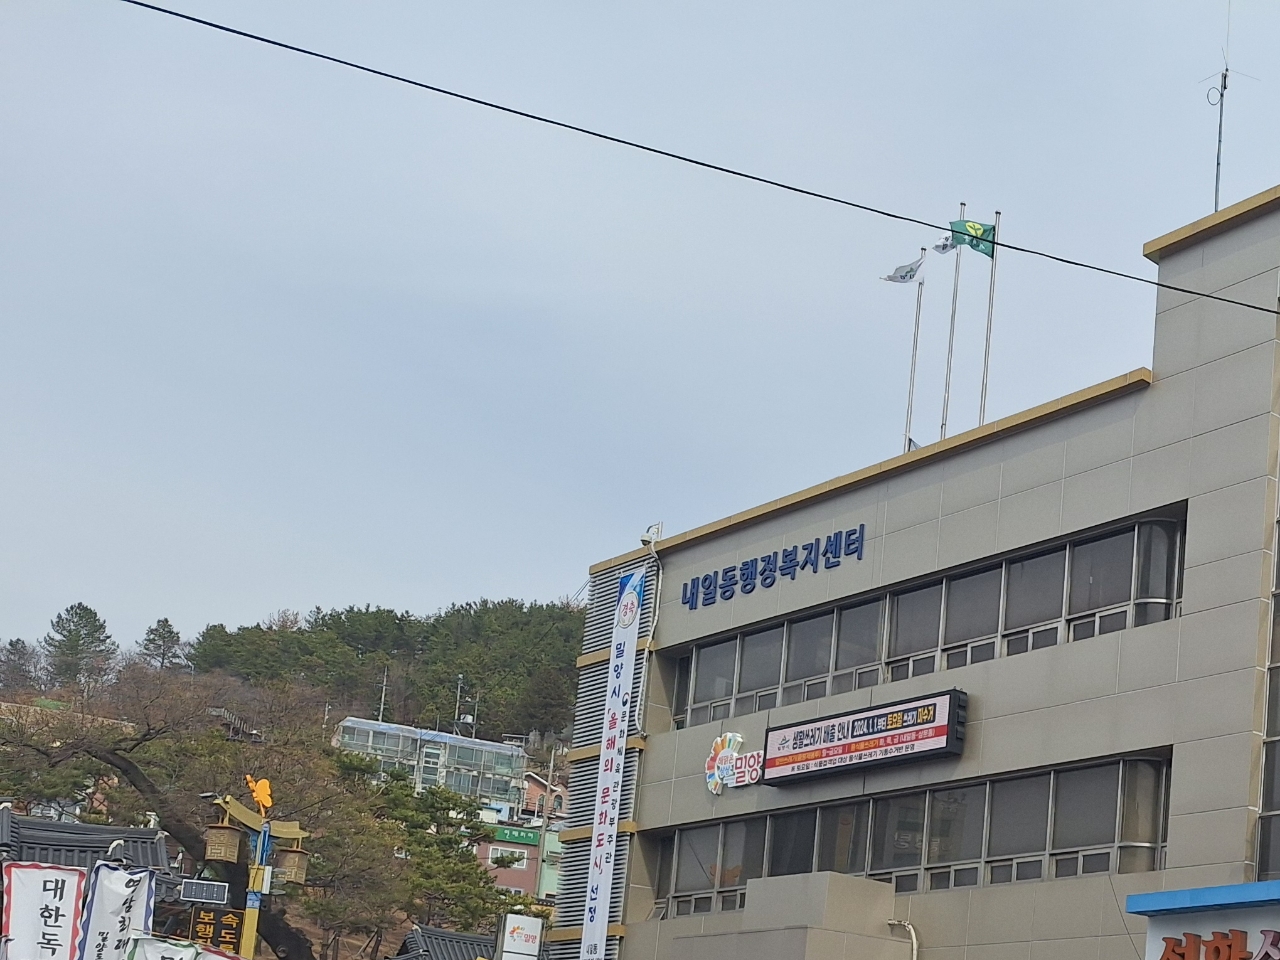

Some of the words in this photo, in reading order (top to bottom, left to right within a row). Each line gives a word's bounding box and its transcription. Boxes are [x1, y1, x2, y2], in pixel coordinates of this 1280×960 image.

[681, 523, 865, 610] 내일동행정복지센터
[621, 600, 636, 617] 경축
[886, 711, 904, 730] 토요일
[917, 704, 935, 724] 미수거
[792, 726, 823, 750] 생활쓰레기
[837, 719, 851, 742] 안내
[735, 751, 762, 784] 밀양
